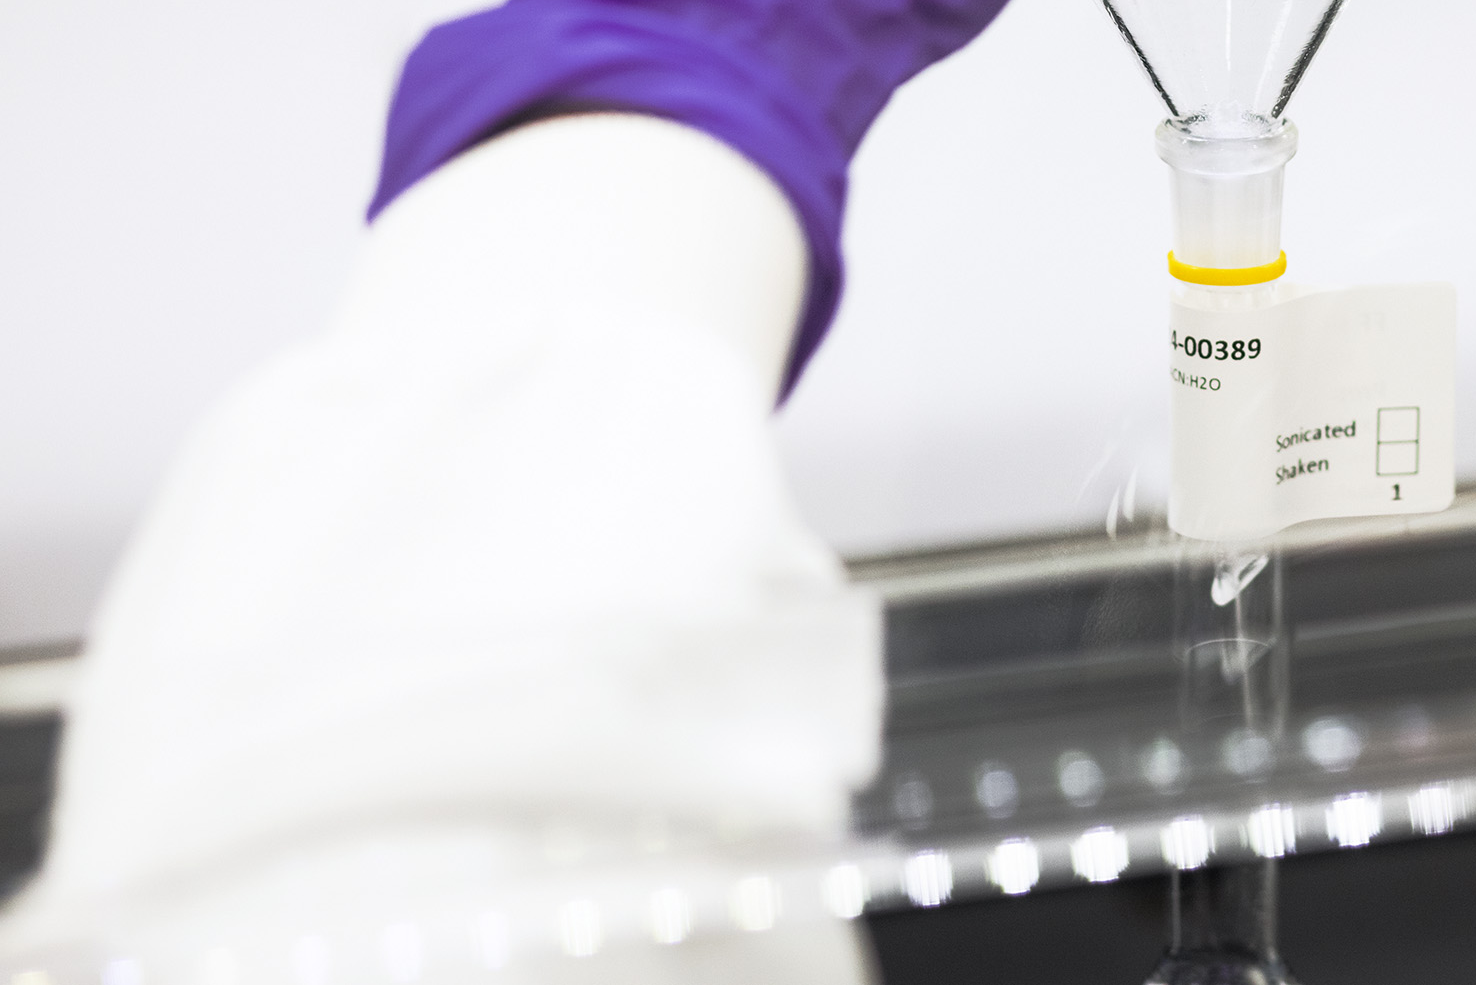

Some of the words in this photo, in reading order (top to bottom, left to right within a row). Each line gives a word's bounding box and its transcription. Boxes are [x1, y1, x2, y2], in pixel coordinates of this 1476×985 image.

[1276, 420, 1356, 452] Sonicated
[1276, 458, 1329, 485] Shaken
[1392, 483, 1402, 501] 1
